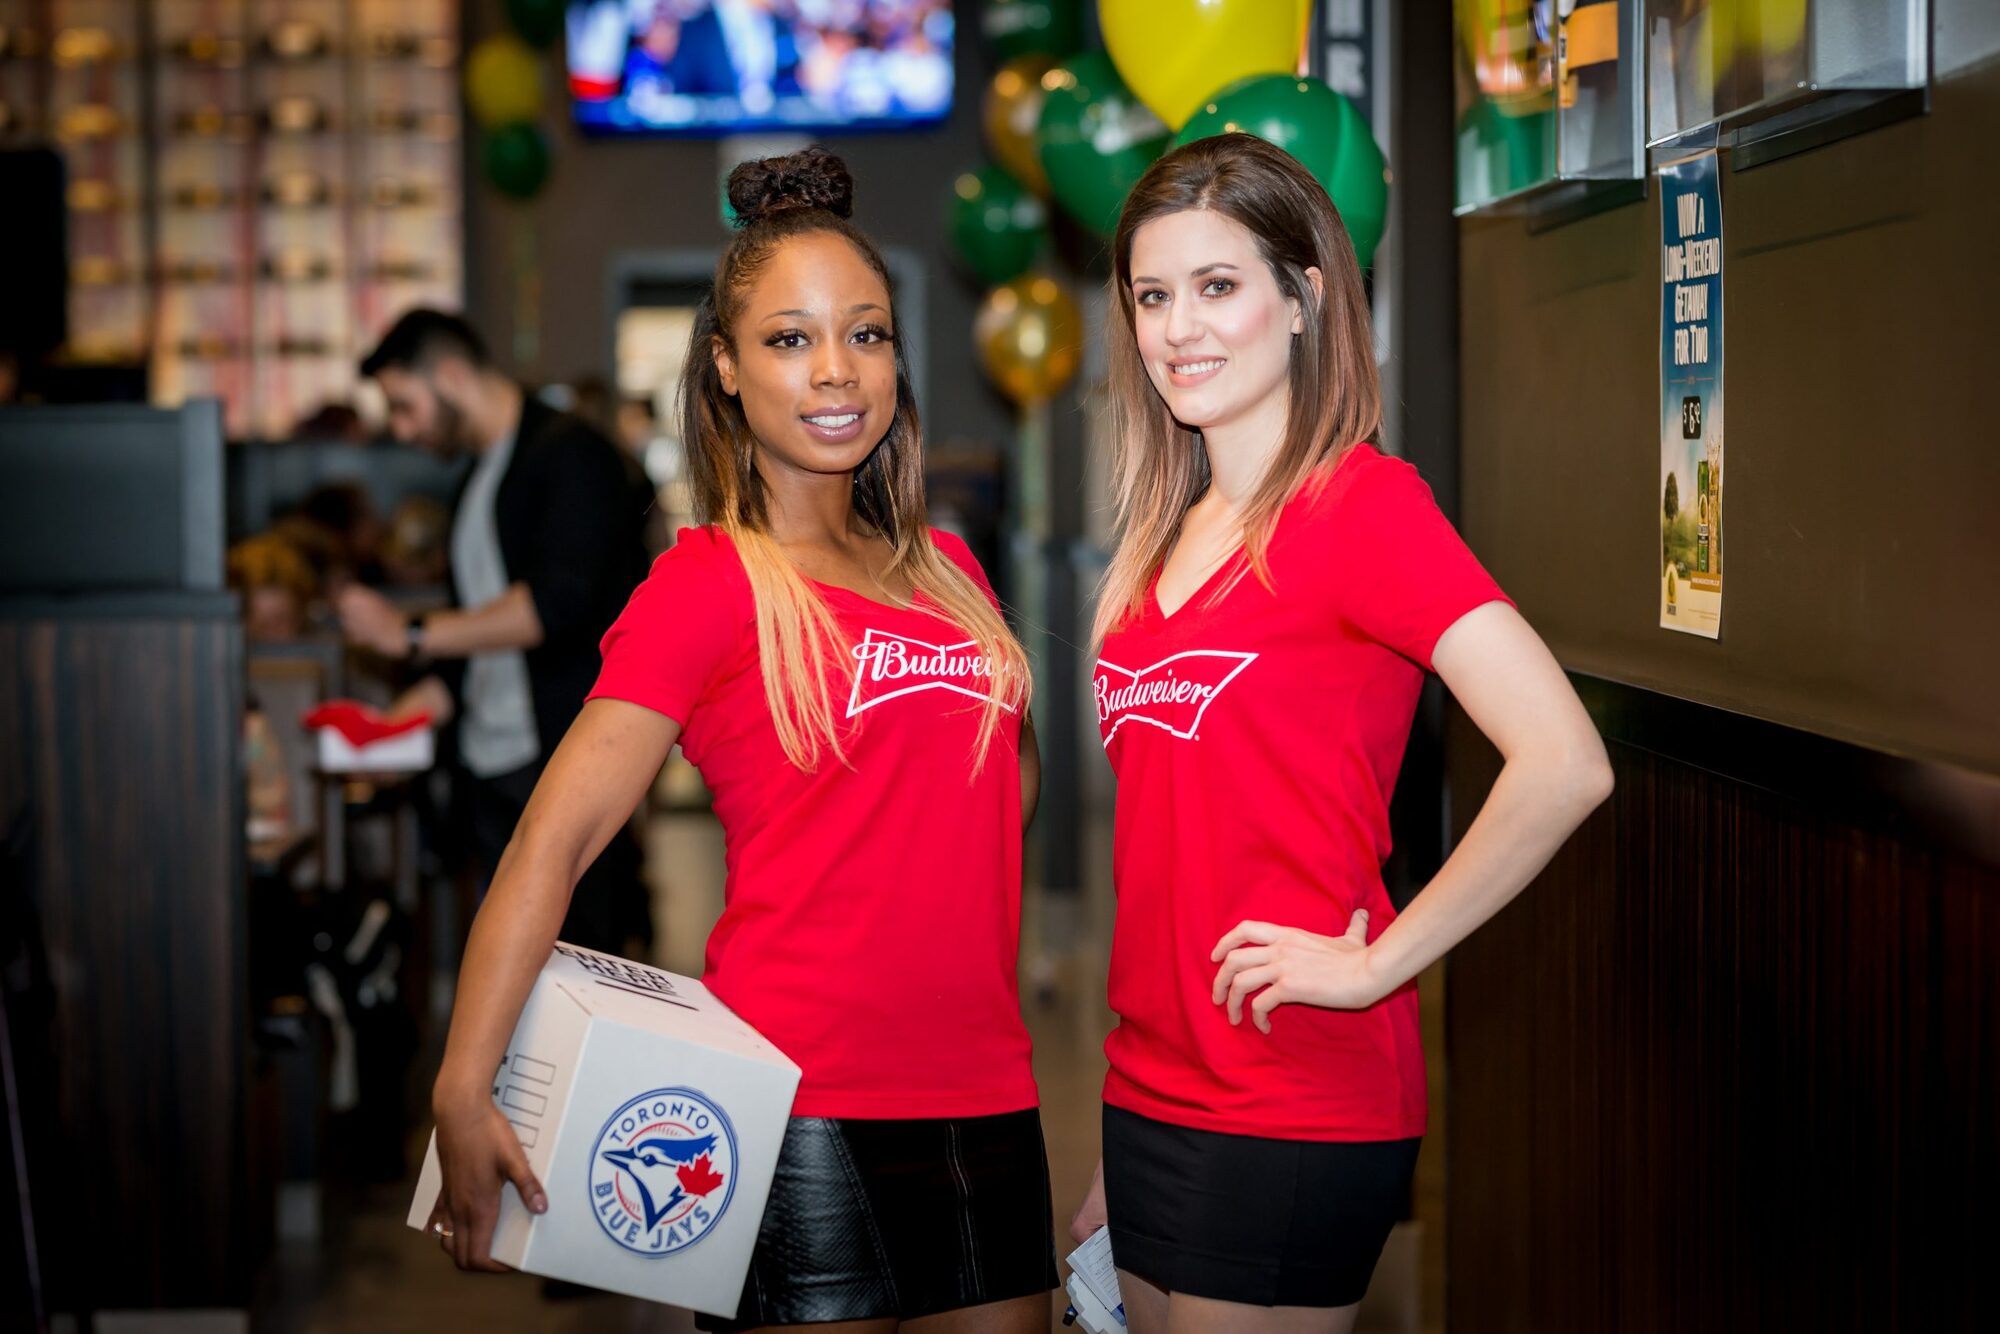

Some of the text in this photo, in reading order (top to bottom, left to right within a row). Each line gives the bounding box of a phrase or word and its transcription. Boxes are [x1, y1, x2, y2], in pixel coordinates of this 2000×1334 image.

[1677, 192, 1705, 238] WIN A
[1664, 237, 1720, 283] LONG-WEEKEND
[1674, 283, 1708, 323] GETAWAY
[1674, 324, 1708, 366] FOR TWO
[852, 640, 1006, 682] Budwei
[1093, 667, 1213, 724] Budweiser
[554, 944, 675, 989] ENTER
[576, 956, 678, 995] HERE
[609, 1101, 710, 1144] TORONTO
[594, 1181, 711, 1249] BLUE JAYS
